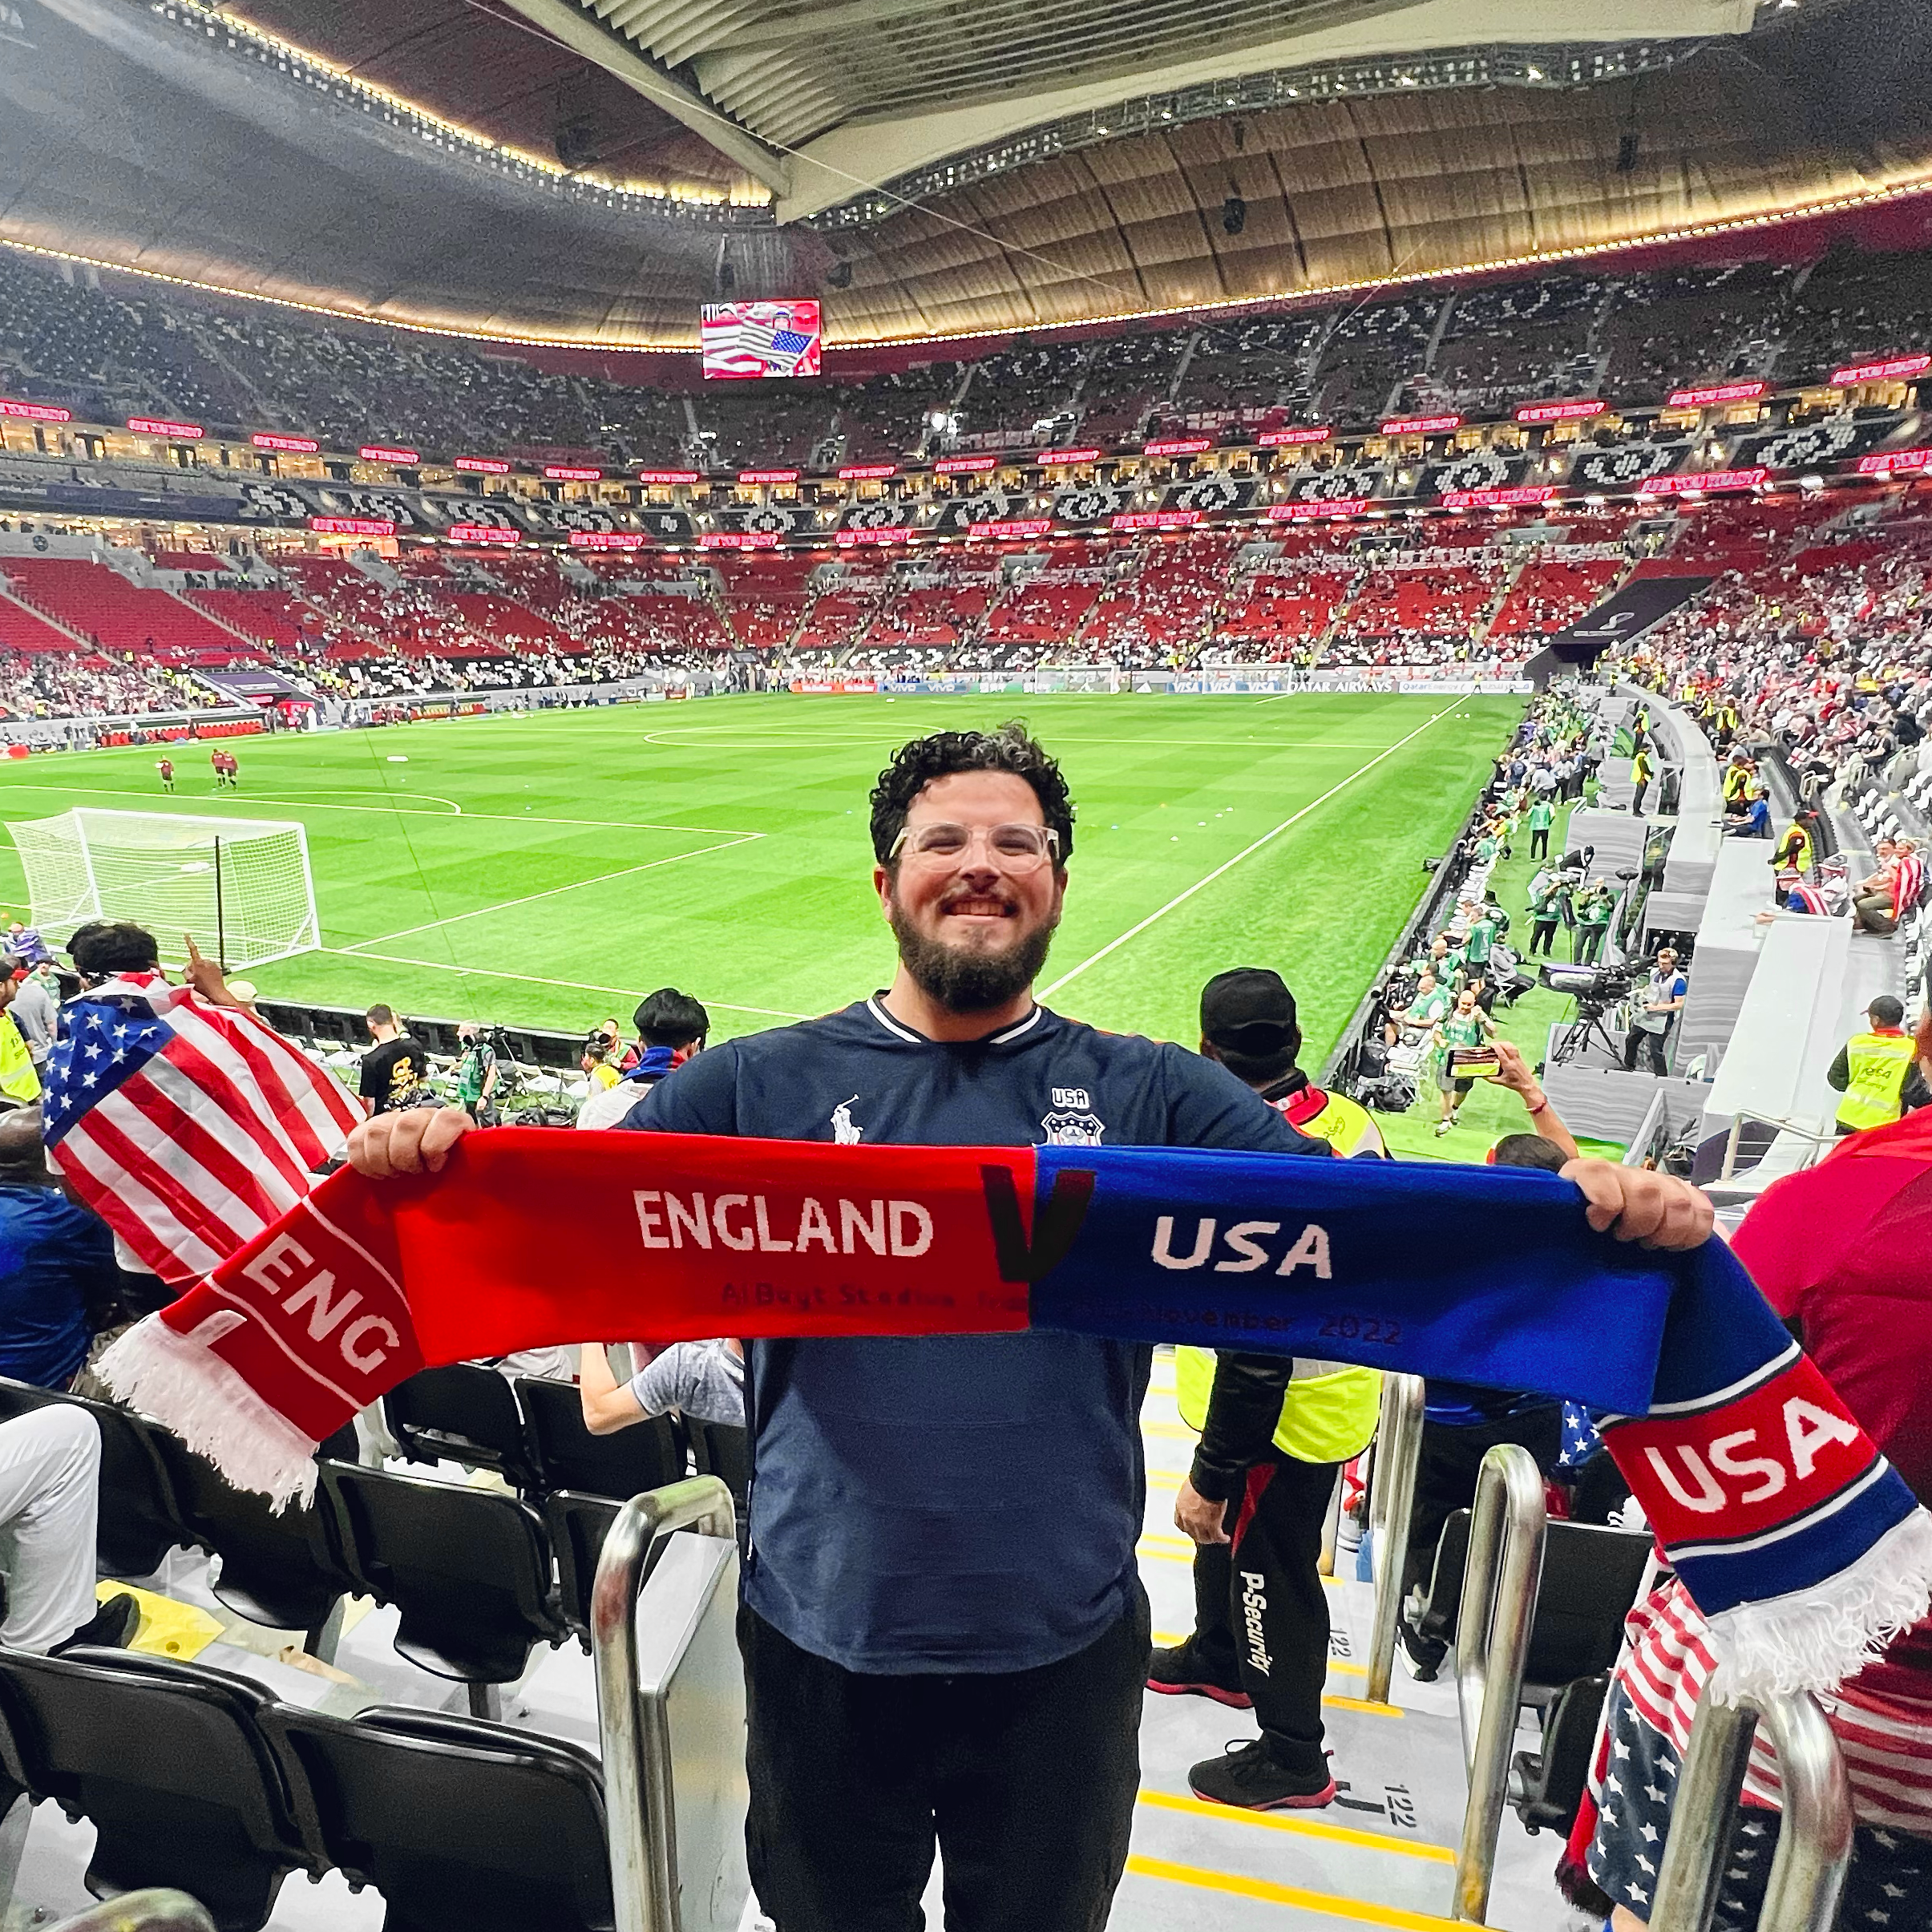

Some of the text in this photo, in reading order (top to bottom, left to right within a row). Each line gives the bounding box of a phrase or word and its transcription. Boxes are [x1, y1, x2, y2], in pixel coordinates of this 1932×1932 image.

[1173, 681, 1199, 693] VISA
[1209, 681, 1237, 693] VISA
[1247, 681, 1275, 693] VISA
[1289, 680, 1394, 693] QATAR AIRWAYS
[1051, 1087, 1089, 1109] USA
[633, 1190, 1332, 1279] ENGLAND USA
[980, 1164, 1097, 1283] V
[241, 1231, 400, 1375] ENG
[1319, 1312, 1402, 1344] 2022
[1644, 1396, 1859, 1514] USA
[1329, 1627, 1352, 1657] 122
[1384, 1784, 1417, 1828] 122
